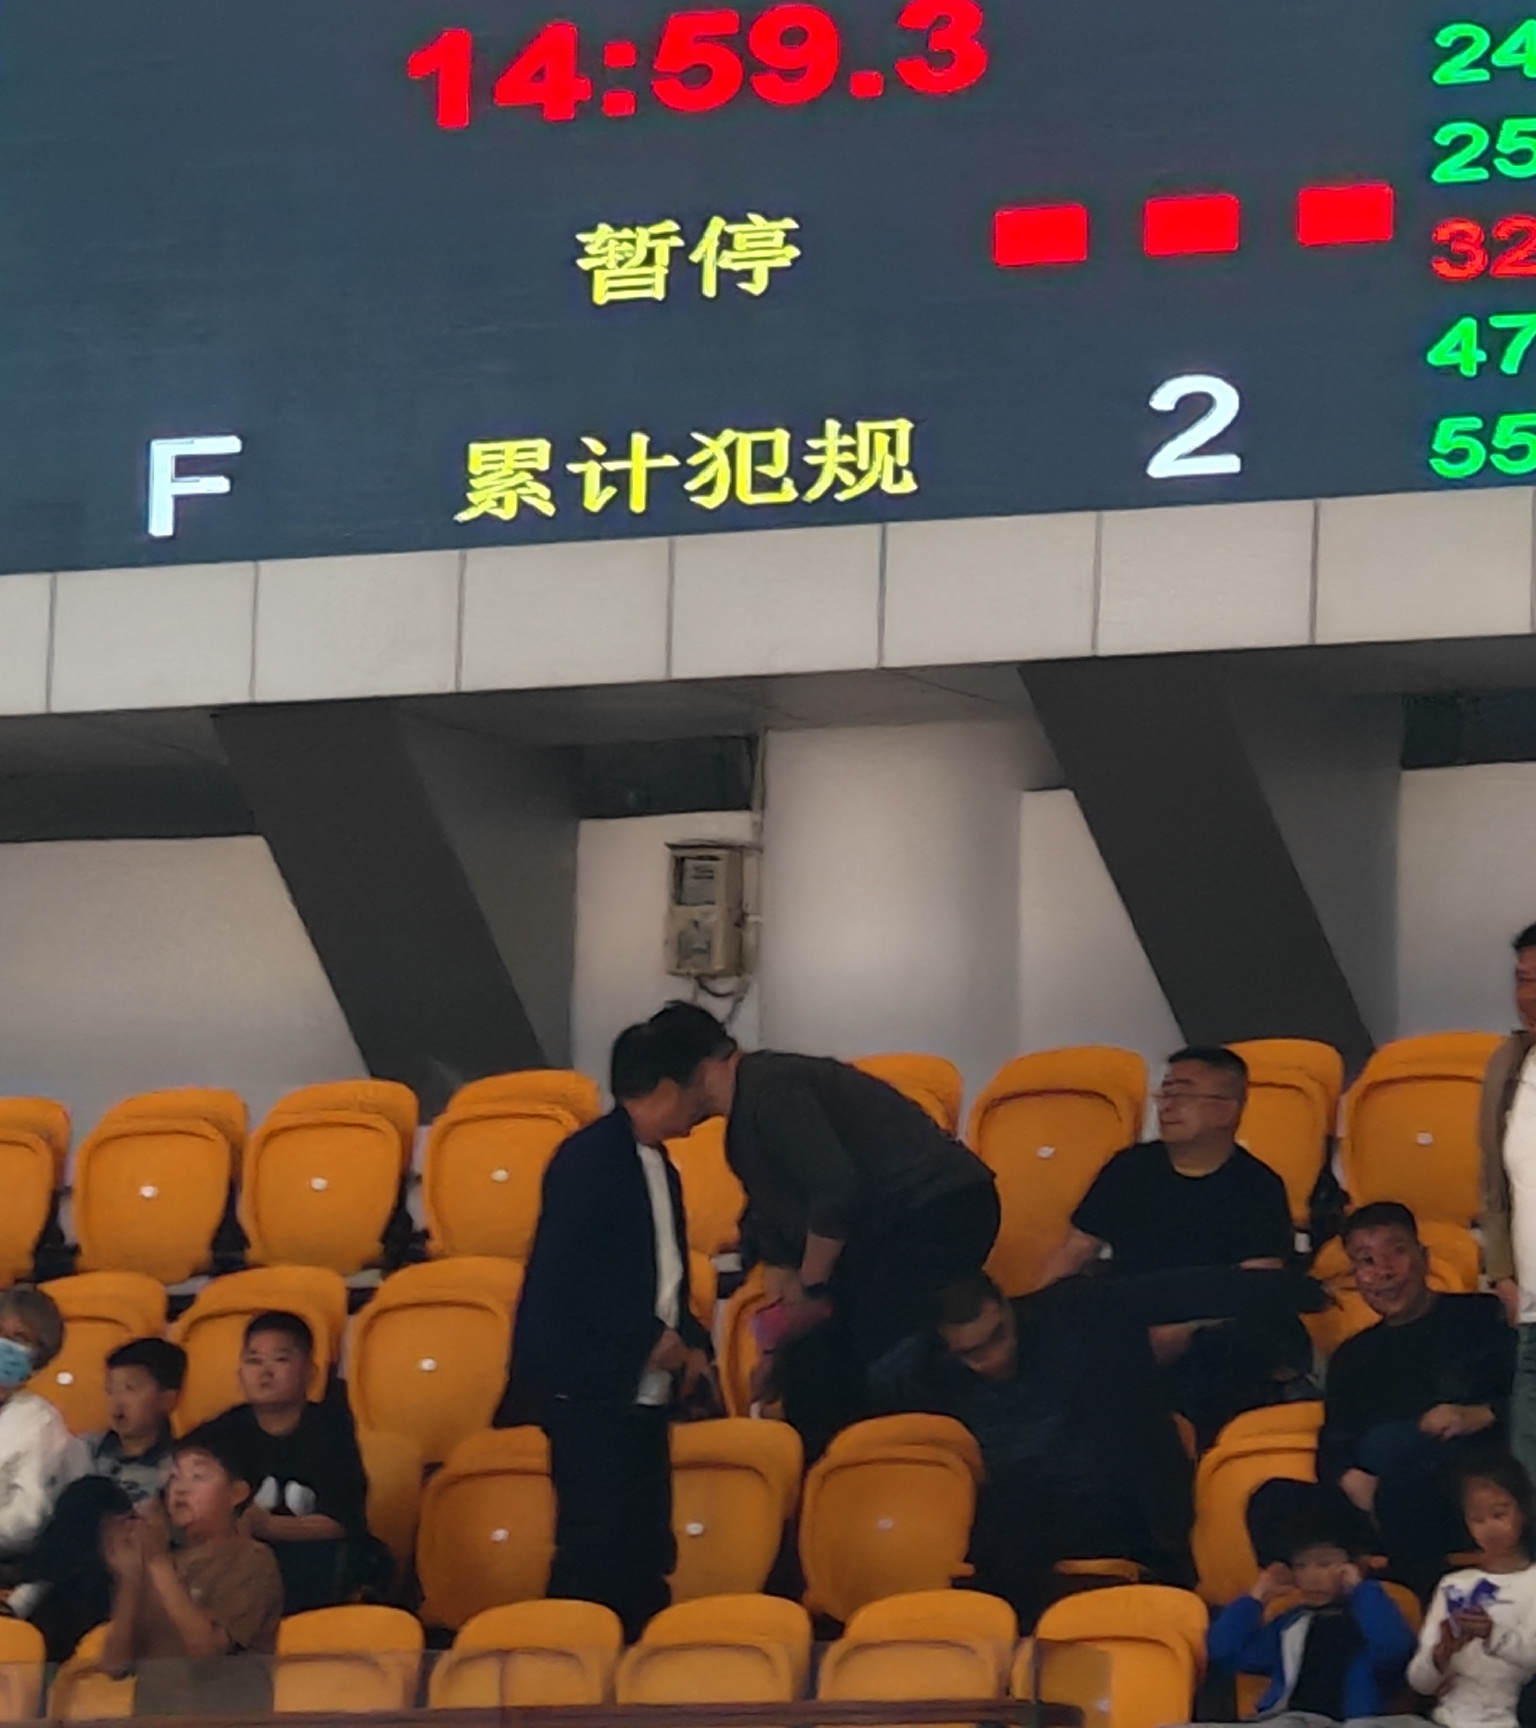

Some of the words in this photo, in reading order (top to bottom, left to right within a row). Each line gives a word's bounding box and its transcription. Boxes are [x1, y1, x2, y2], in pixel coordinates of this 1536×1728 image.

[574, 211, 800, 305] 暂停
[453, 416, 917, 524] 累计犯规
[1146, 375, 1242, 479] 2
[148, 435, 242, 538] F
